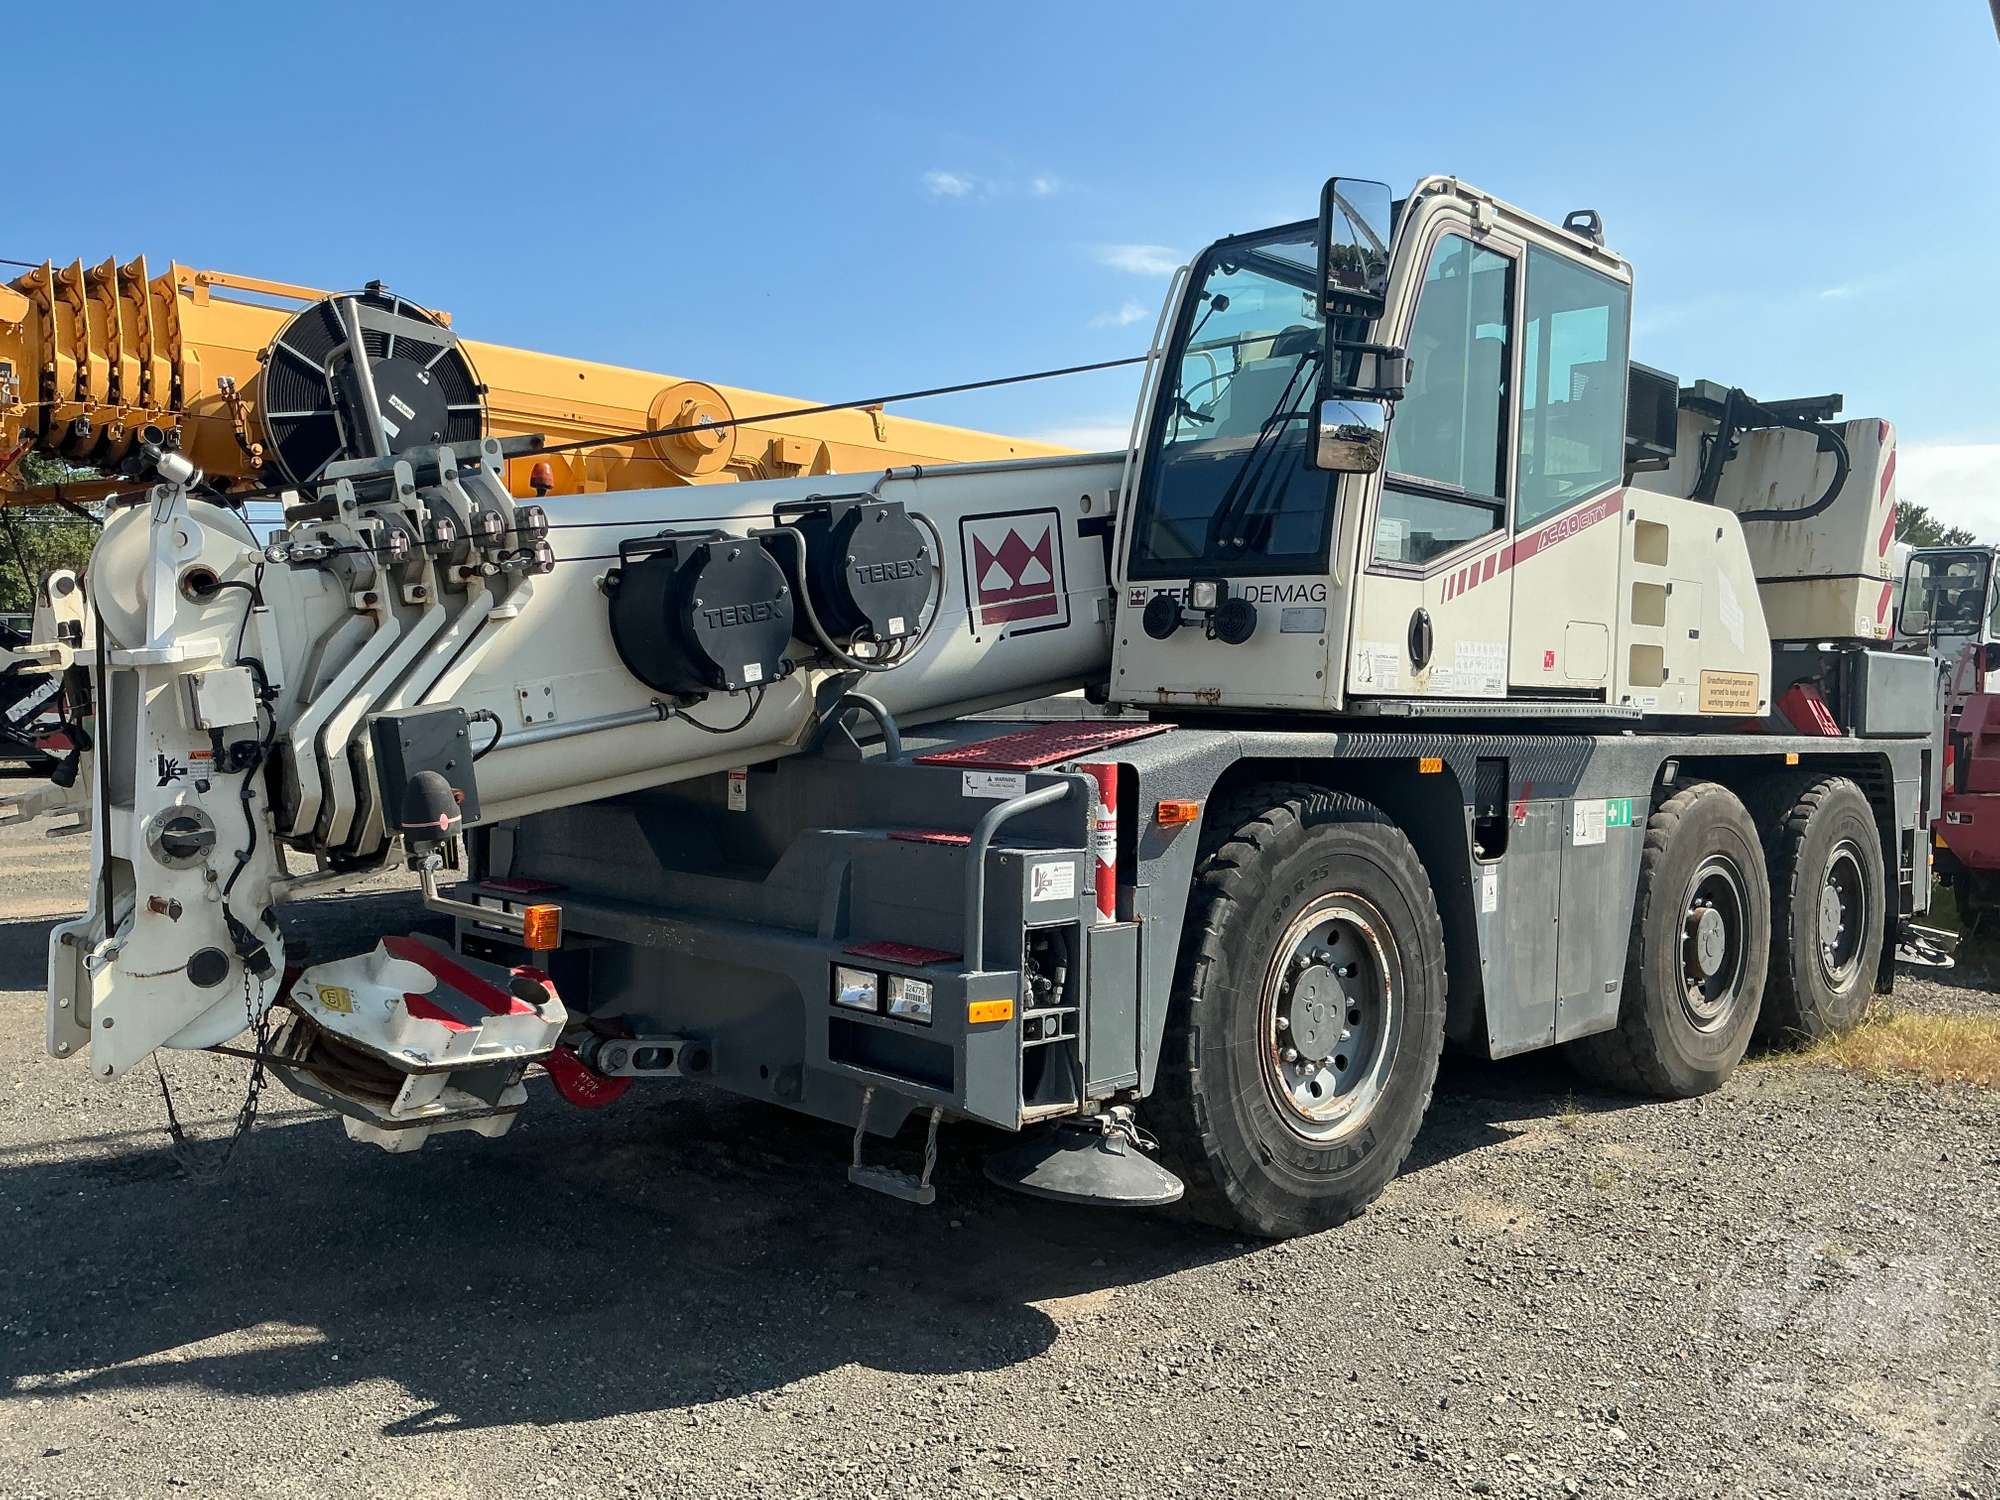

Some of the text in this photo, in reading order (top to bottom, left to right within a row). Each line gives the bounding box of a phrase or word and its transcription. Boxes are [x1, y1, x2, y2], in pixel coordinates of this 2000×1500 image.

[856, 558, 925, 584] TEREX
[1245, 583, 1327, 604] DEMAG
[703, 600, 784, 629] TEREX
